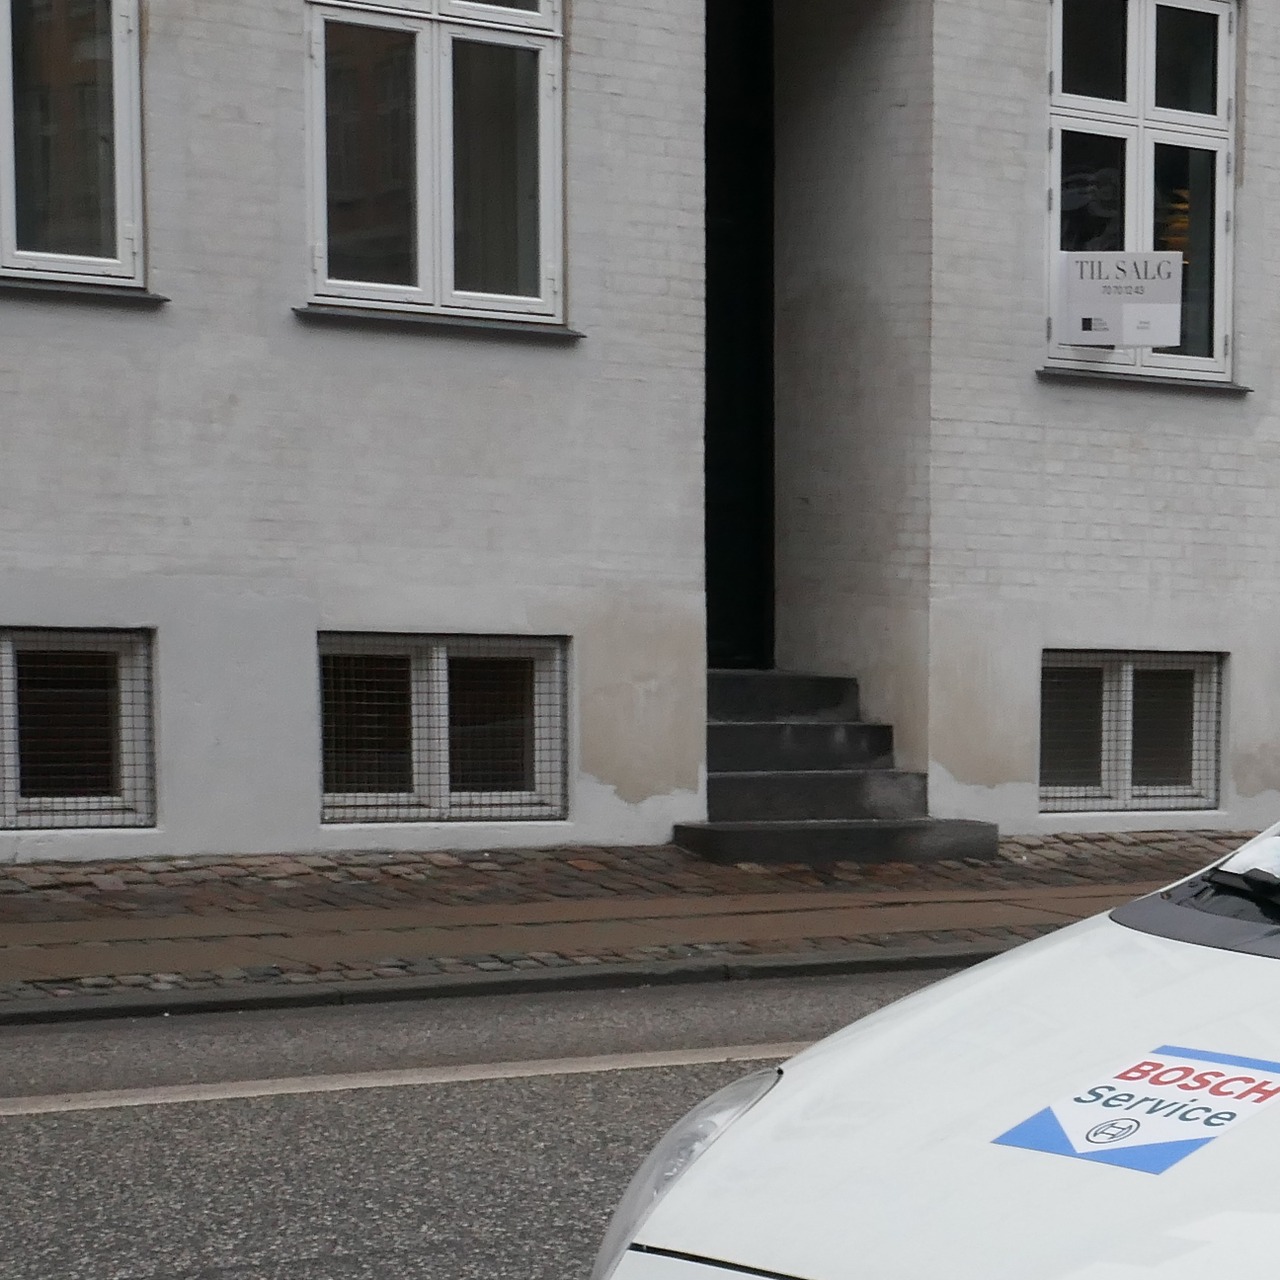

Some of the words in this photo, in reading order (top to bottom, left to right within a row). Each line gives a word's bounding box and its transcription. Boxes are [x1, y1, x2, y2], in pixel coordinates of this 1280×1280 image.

[1075, 260, 1109, 280] TIL
[1115, 260, 1173, 280] SALG
[1073, 1085, 1237, 1127] Service
